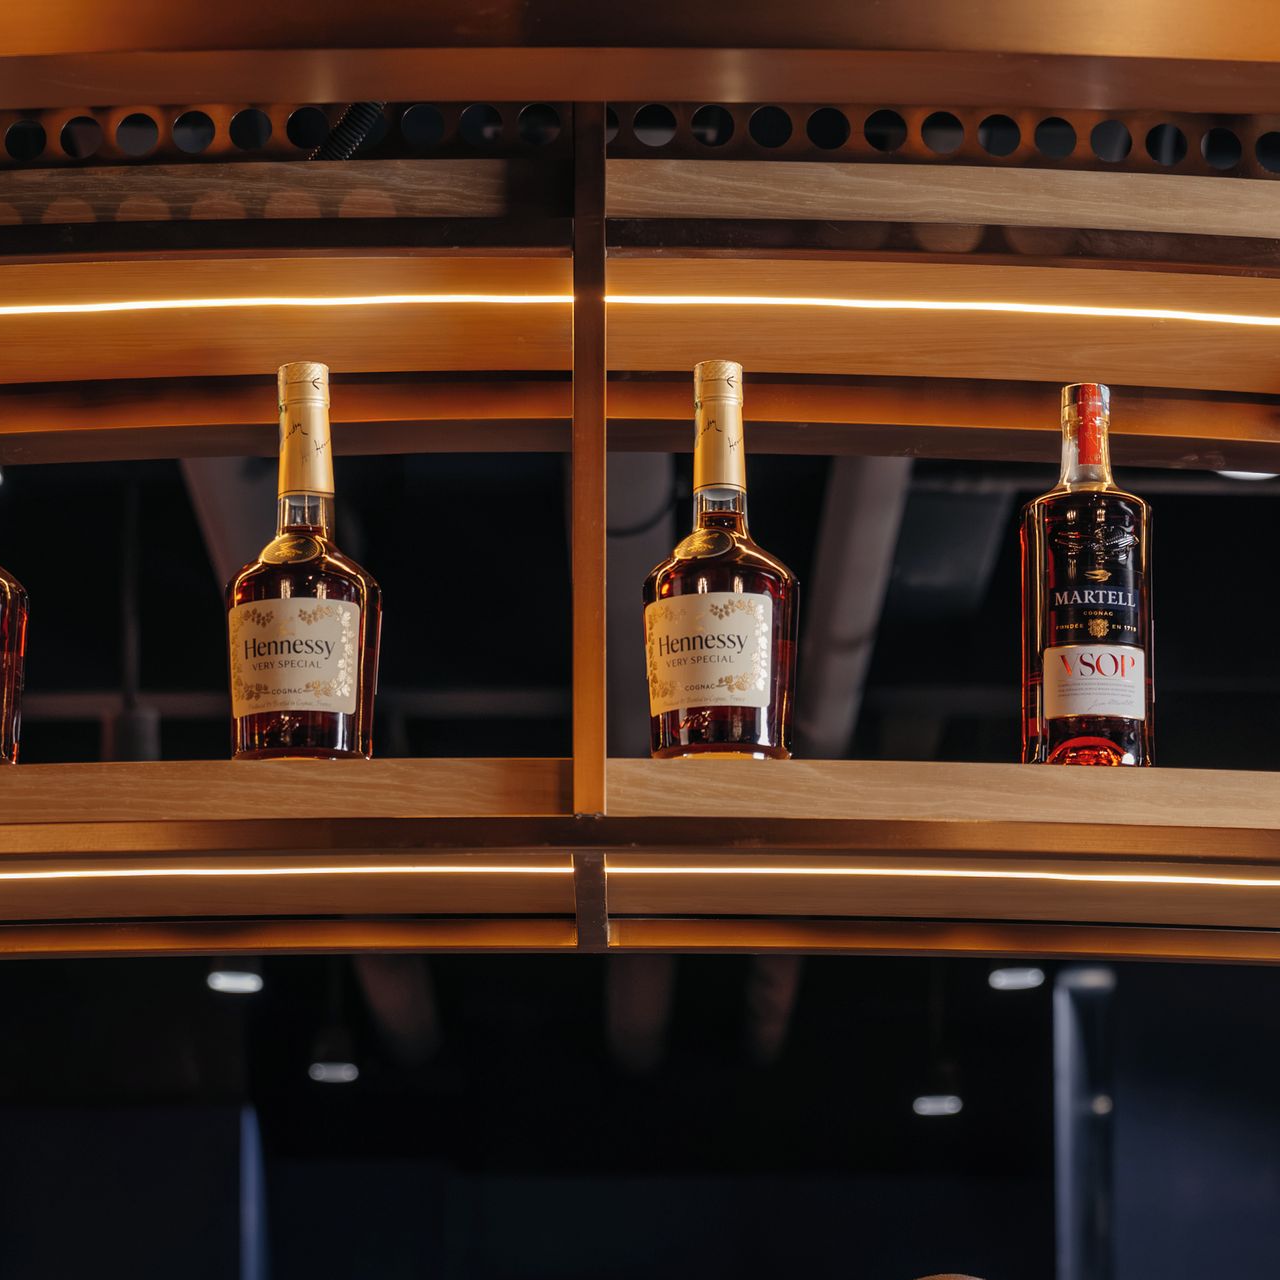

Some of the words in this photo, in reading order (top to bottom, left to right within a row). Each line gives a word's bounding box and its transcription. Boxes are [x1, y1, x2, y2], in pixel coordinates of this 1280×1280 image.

[1055, 590, 1136, 607] MARTELL
[244, 638, 336, 660] Hennessy
[659, 633, 749, 657] Hennessy
[252, 660, 275, 671] VERY
[278, 659, 322, 669] SPECIAL
[666, 656, 688, 668] VERY
[690, 655, 734, 664] SPECIAL
[1059, 653, 1135, 677] VSOP
[271, 688, 303, 696] COGNAC
